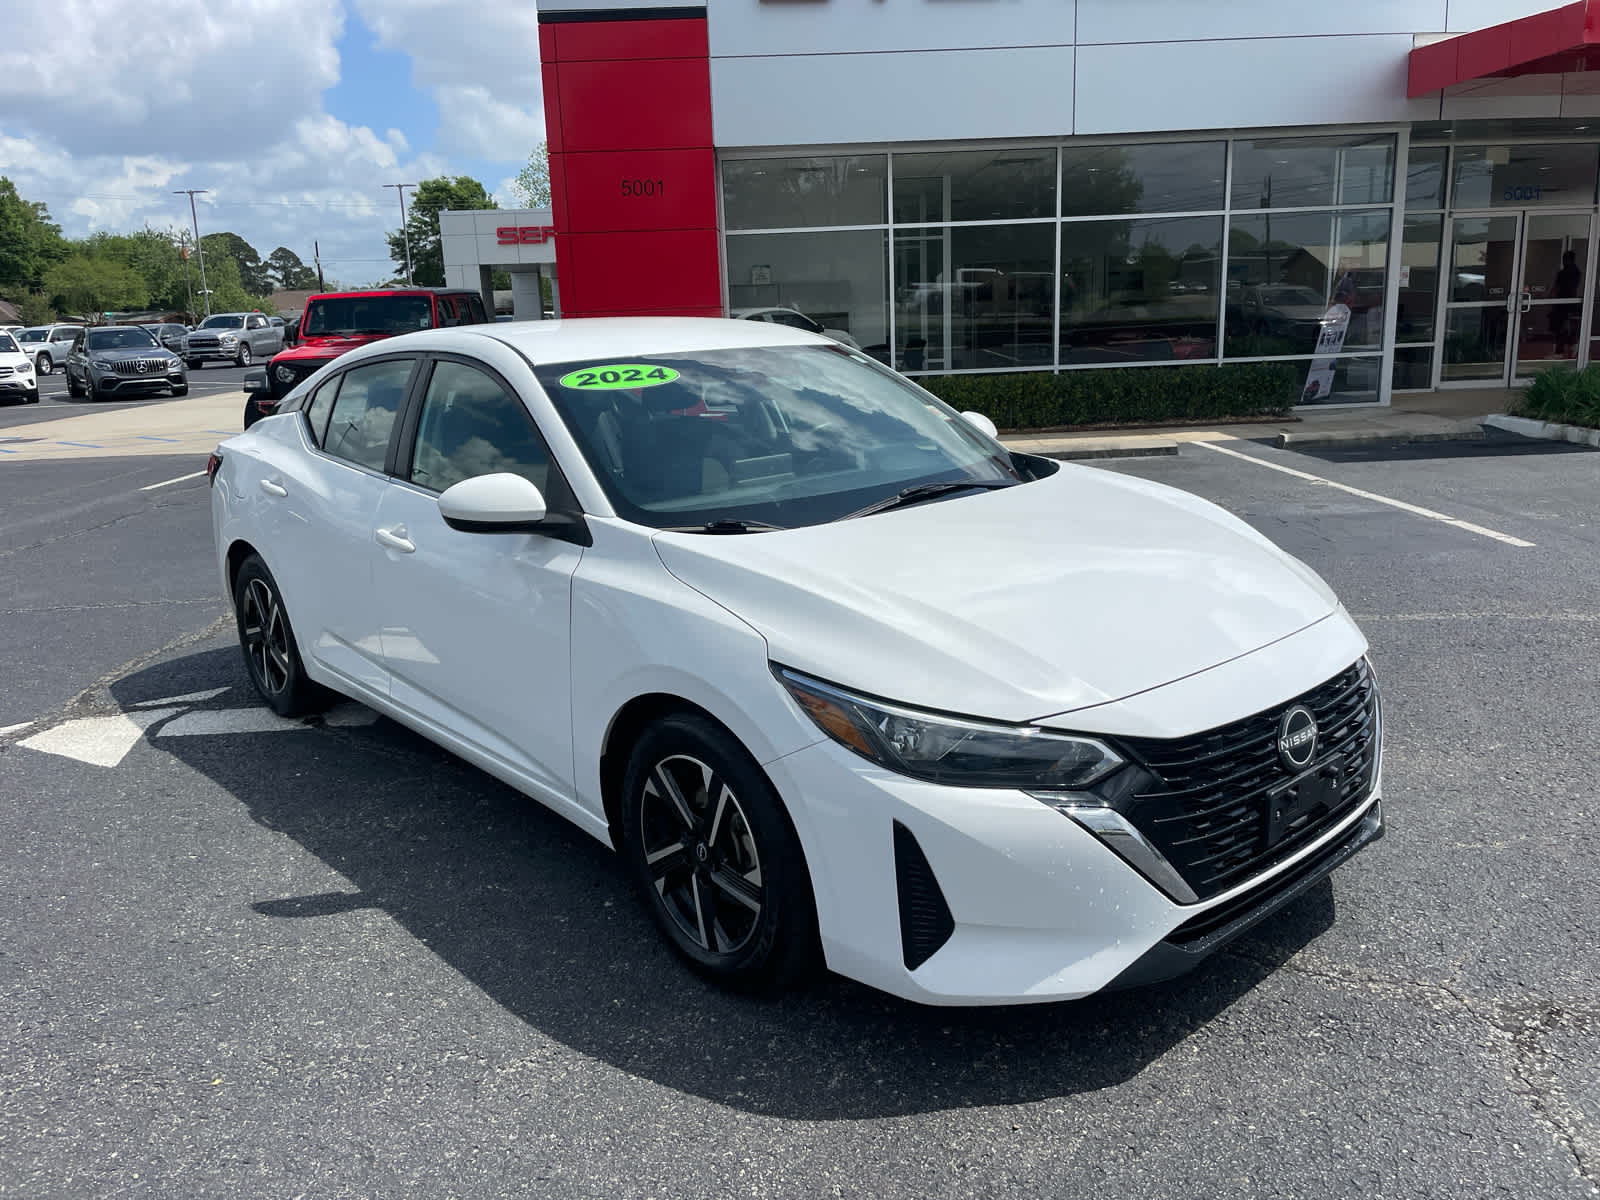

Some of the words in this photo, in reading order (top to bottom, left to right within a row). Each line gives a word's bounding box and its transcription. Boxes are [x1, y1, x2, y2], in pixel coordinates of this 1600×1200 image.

[621, 180, 665, 197] 5001
[575, 368, 667, 386] 2024
[1280, 726, 1317, 750] NISSAN
